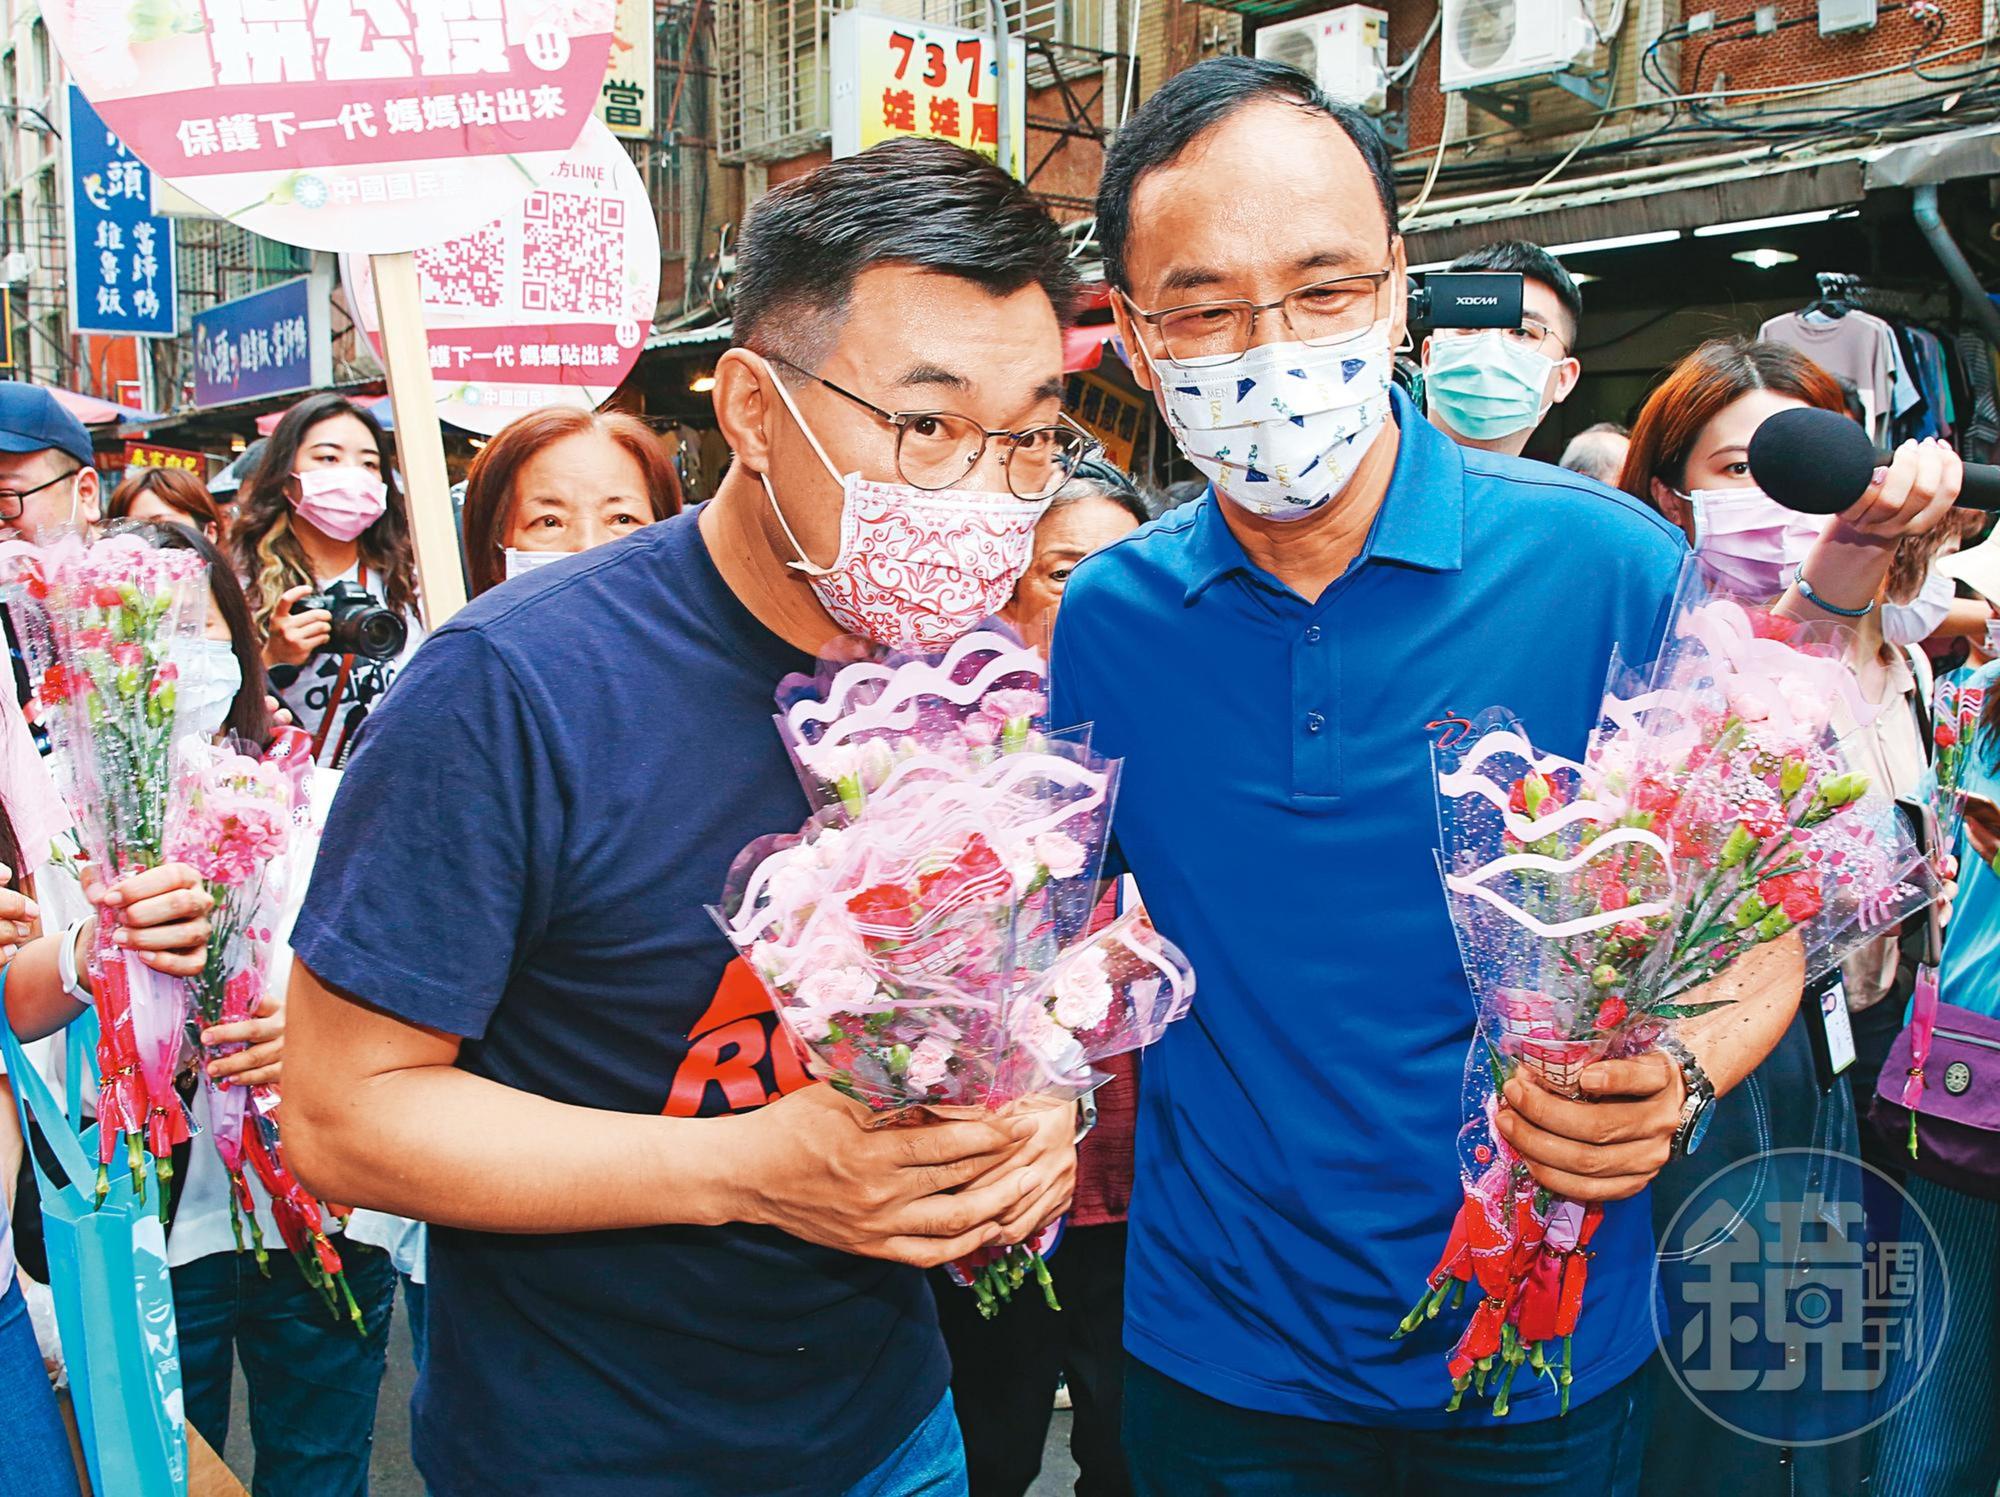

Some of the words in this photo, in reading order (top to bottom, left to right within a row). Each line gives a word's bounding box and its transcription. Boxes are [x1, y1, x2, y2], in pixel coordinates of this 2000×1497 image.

[889, 31, 981, 98] 737
[176, 102, 378, 158] 保護下一代
[383, 84, 567, 136] 媽媽站出來
[551, 161, 605, 180] 方LINE
[331, 171, 466, 205] 中國國民
[1455, 296, 1499, 306] XDCAM
[520, 344, 619, 367] 媽媽站出來
